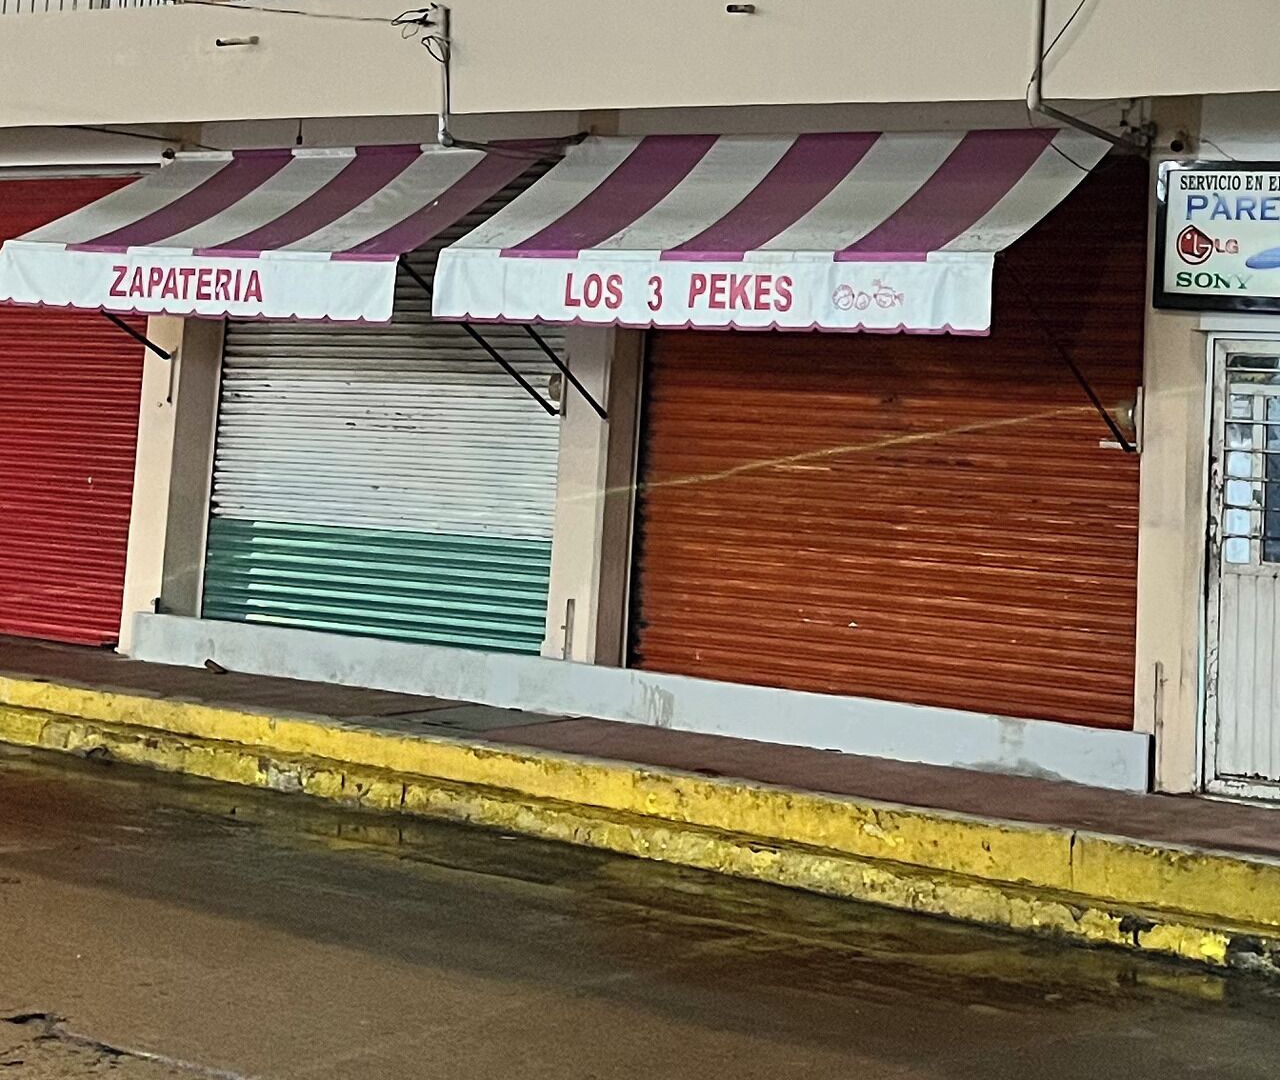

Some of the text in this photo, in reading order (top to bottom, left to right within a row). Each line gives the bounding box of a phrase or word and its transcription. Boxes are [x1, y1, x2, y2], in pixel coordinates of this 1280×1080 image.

[1180, 174, 1241, 191] SERVICIO
[1246, 175, 1263, 191] EN
[1215, 238, 1239, 254] LG
[109, 265, 263, 303] ZAPATERIA
[1176, 272, 1252, 289] SONY
[563, 272, 794, 312] LOS 3 PEKES
